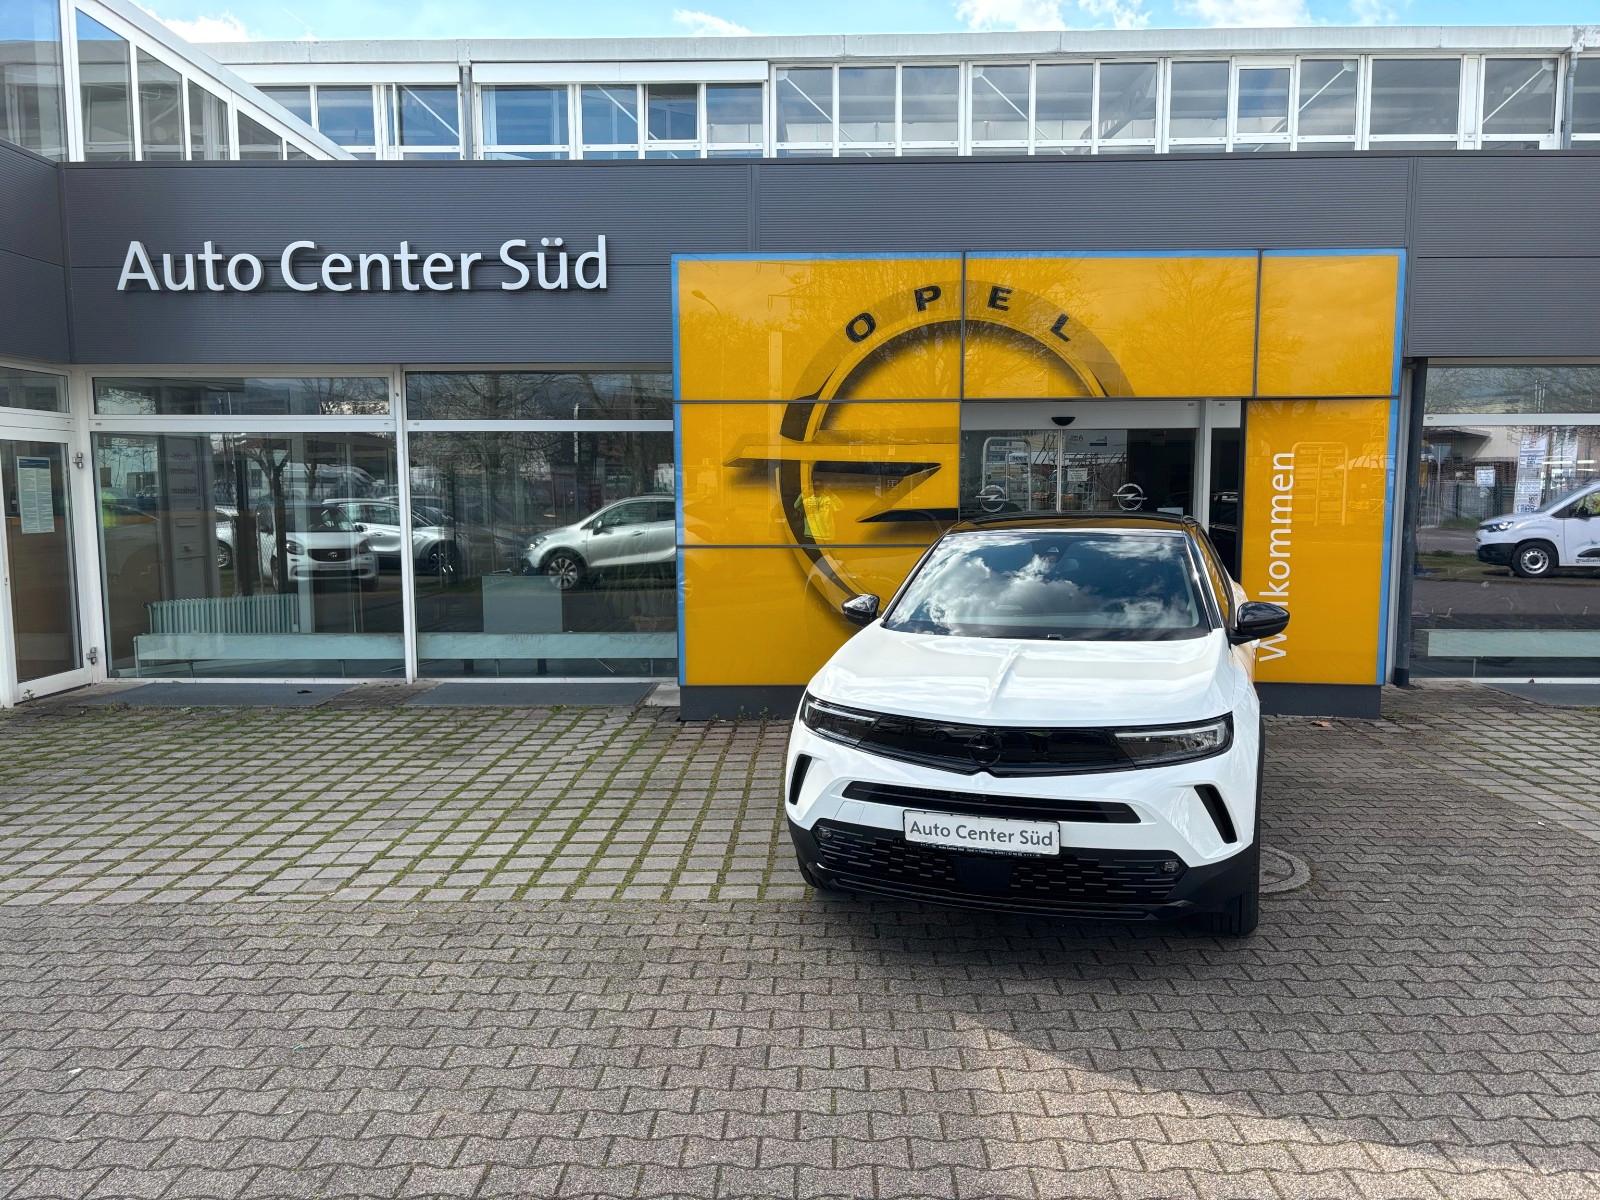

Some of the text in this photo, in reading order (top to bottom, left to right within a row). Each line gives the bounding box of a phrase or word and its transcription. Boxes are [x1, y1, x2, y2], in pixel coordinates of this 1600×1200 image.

[117, 234, 608, 293] Auto Center Süd
[845, 285, 1072, 344] OPEL
[1258, 452, 1295, 662] Wlkommen
[910, 820, 1053, 847] Auto Center Süd
